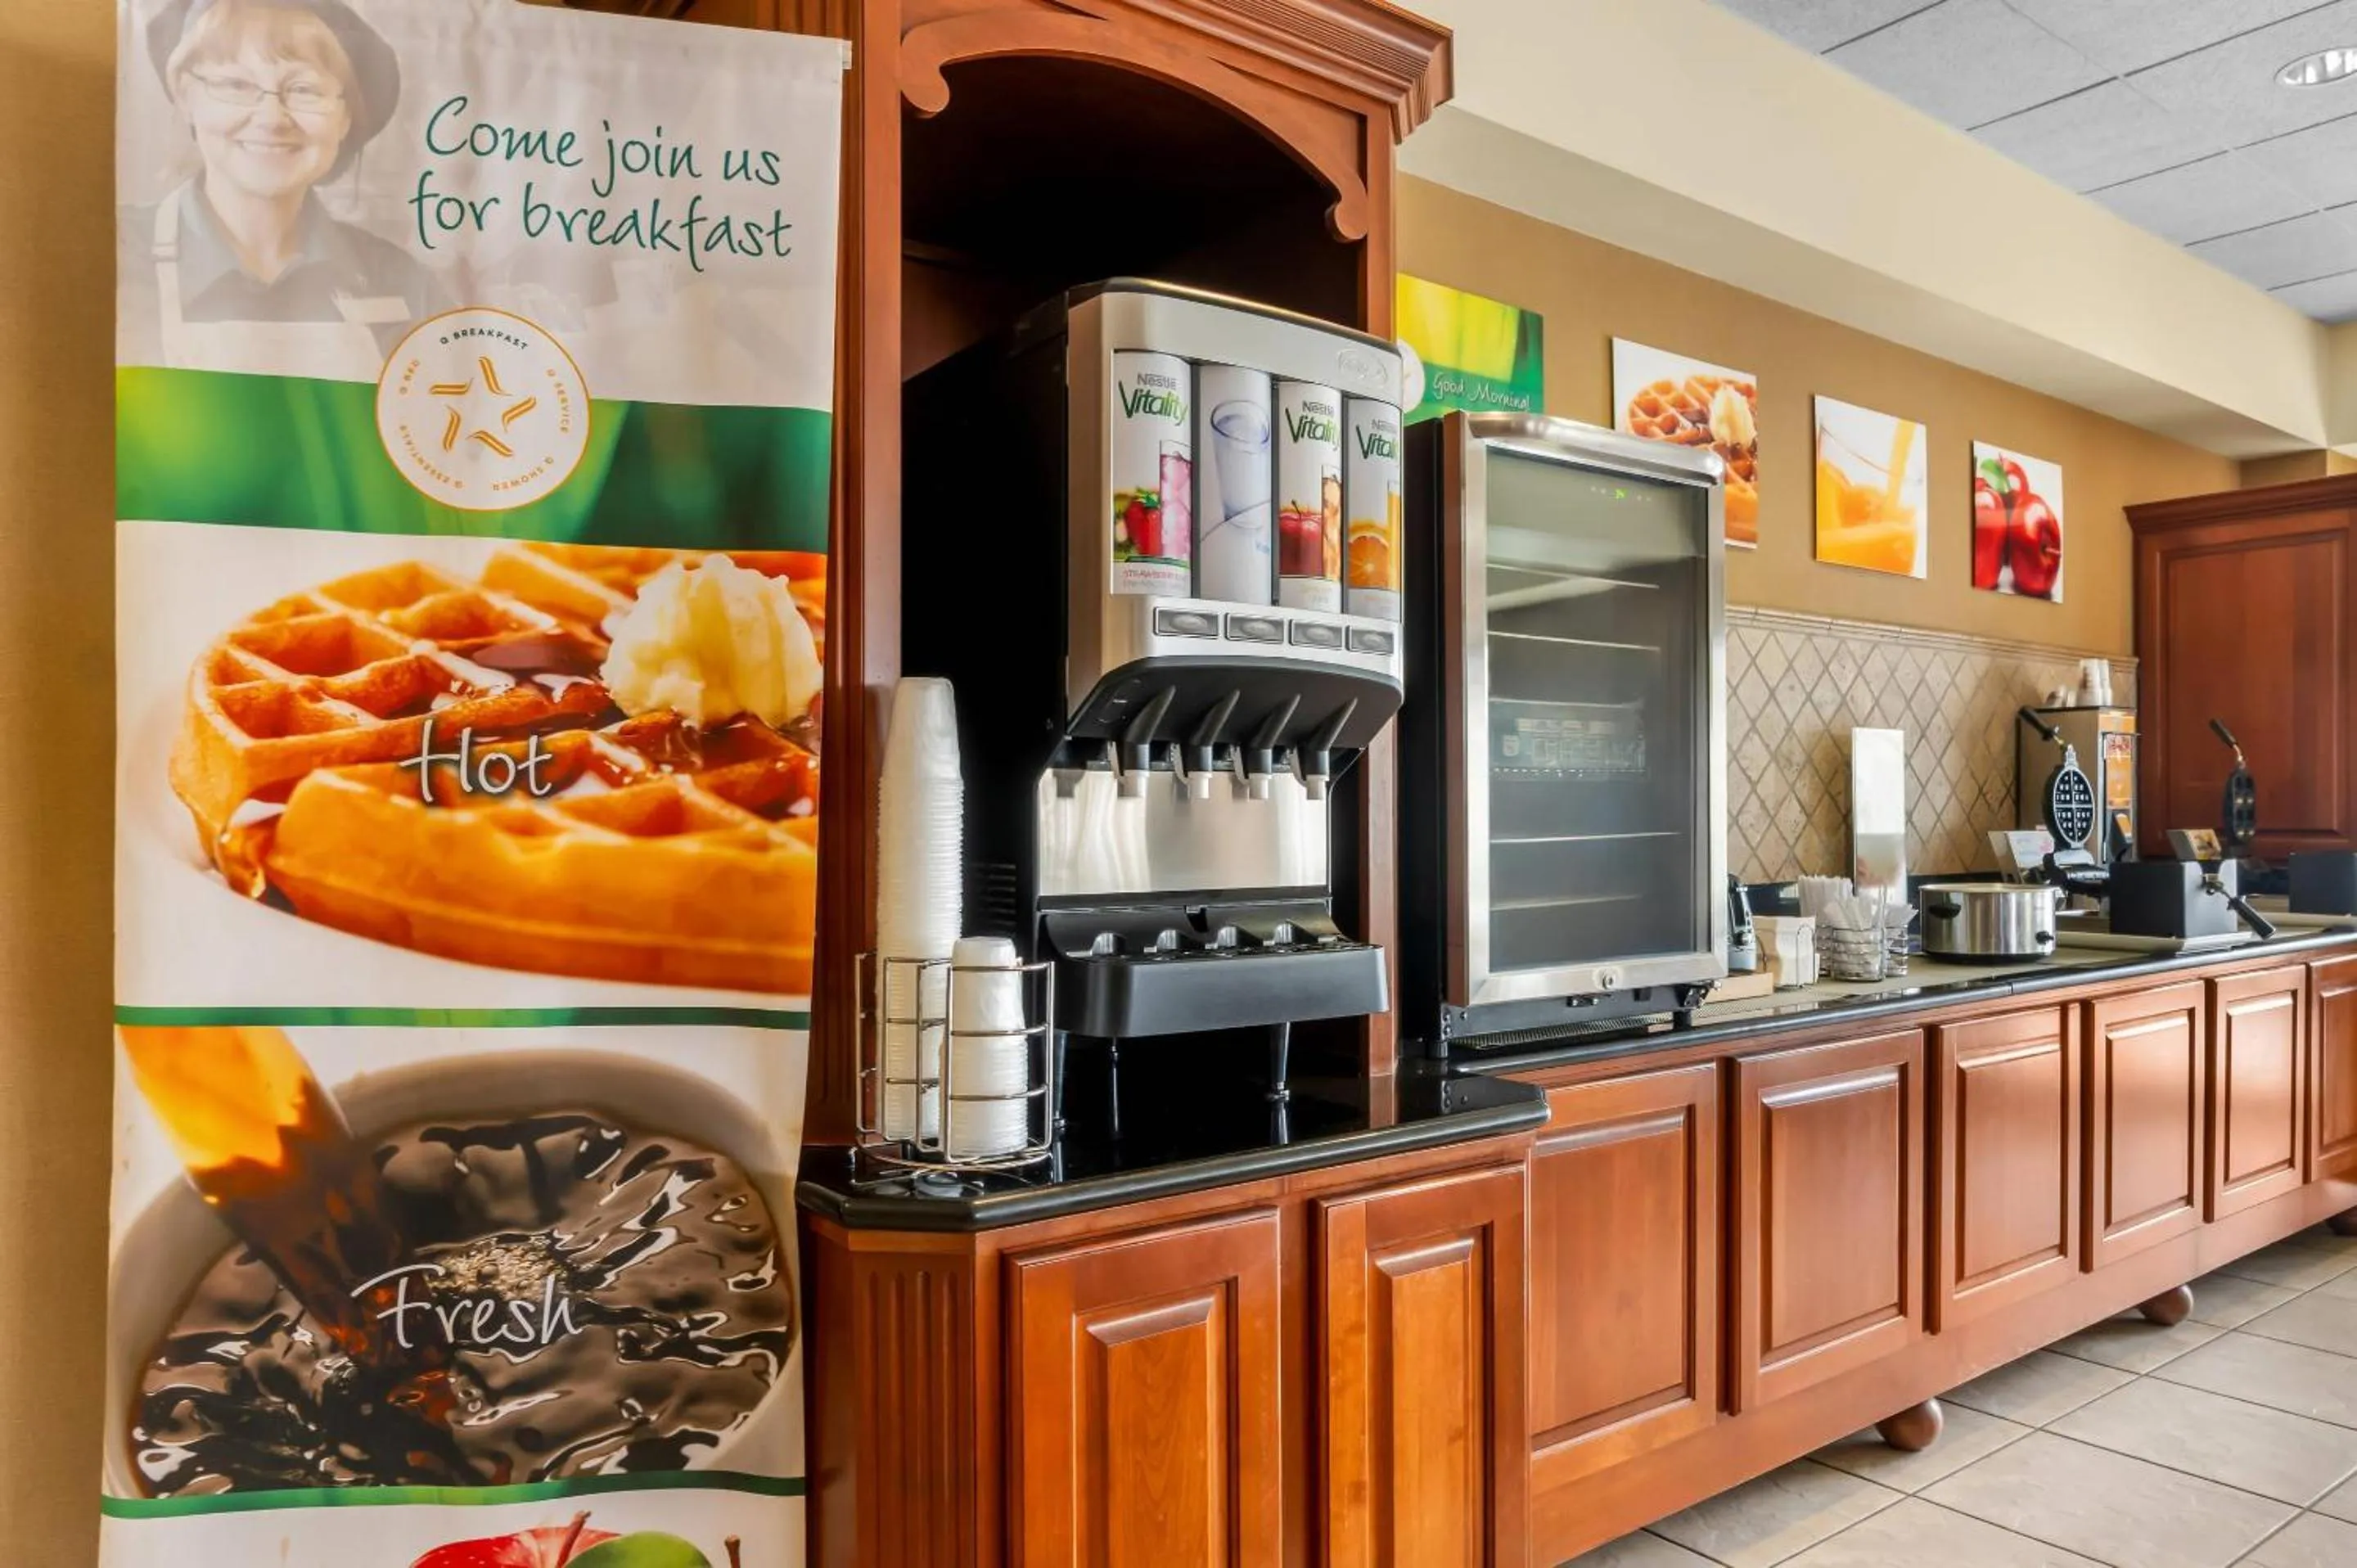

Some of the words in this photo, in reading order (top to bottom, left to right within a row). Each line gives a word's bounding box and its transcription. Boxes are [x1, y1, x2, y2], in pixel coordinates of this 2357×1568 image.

[426, 95, 584, 168] Come
[591, 119, 703, 198] join
[722, 147, 782, 186] us
[408, 169, 500, 250] for
[522, 182, 794, 273] breakfast
[453, 327, 529, 350] BREAKFAST
[1117, 379, 1188, 426] Vitality
[1433, 372, 1464, 400] Good
[399, 719, 553, 803] Hot
[350, 1263, 584, 1349] Fresh
